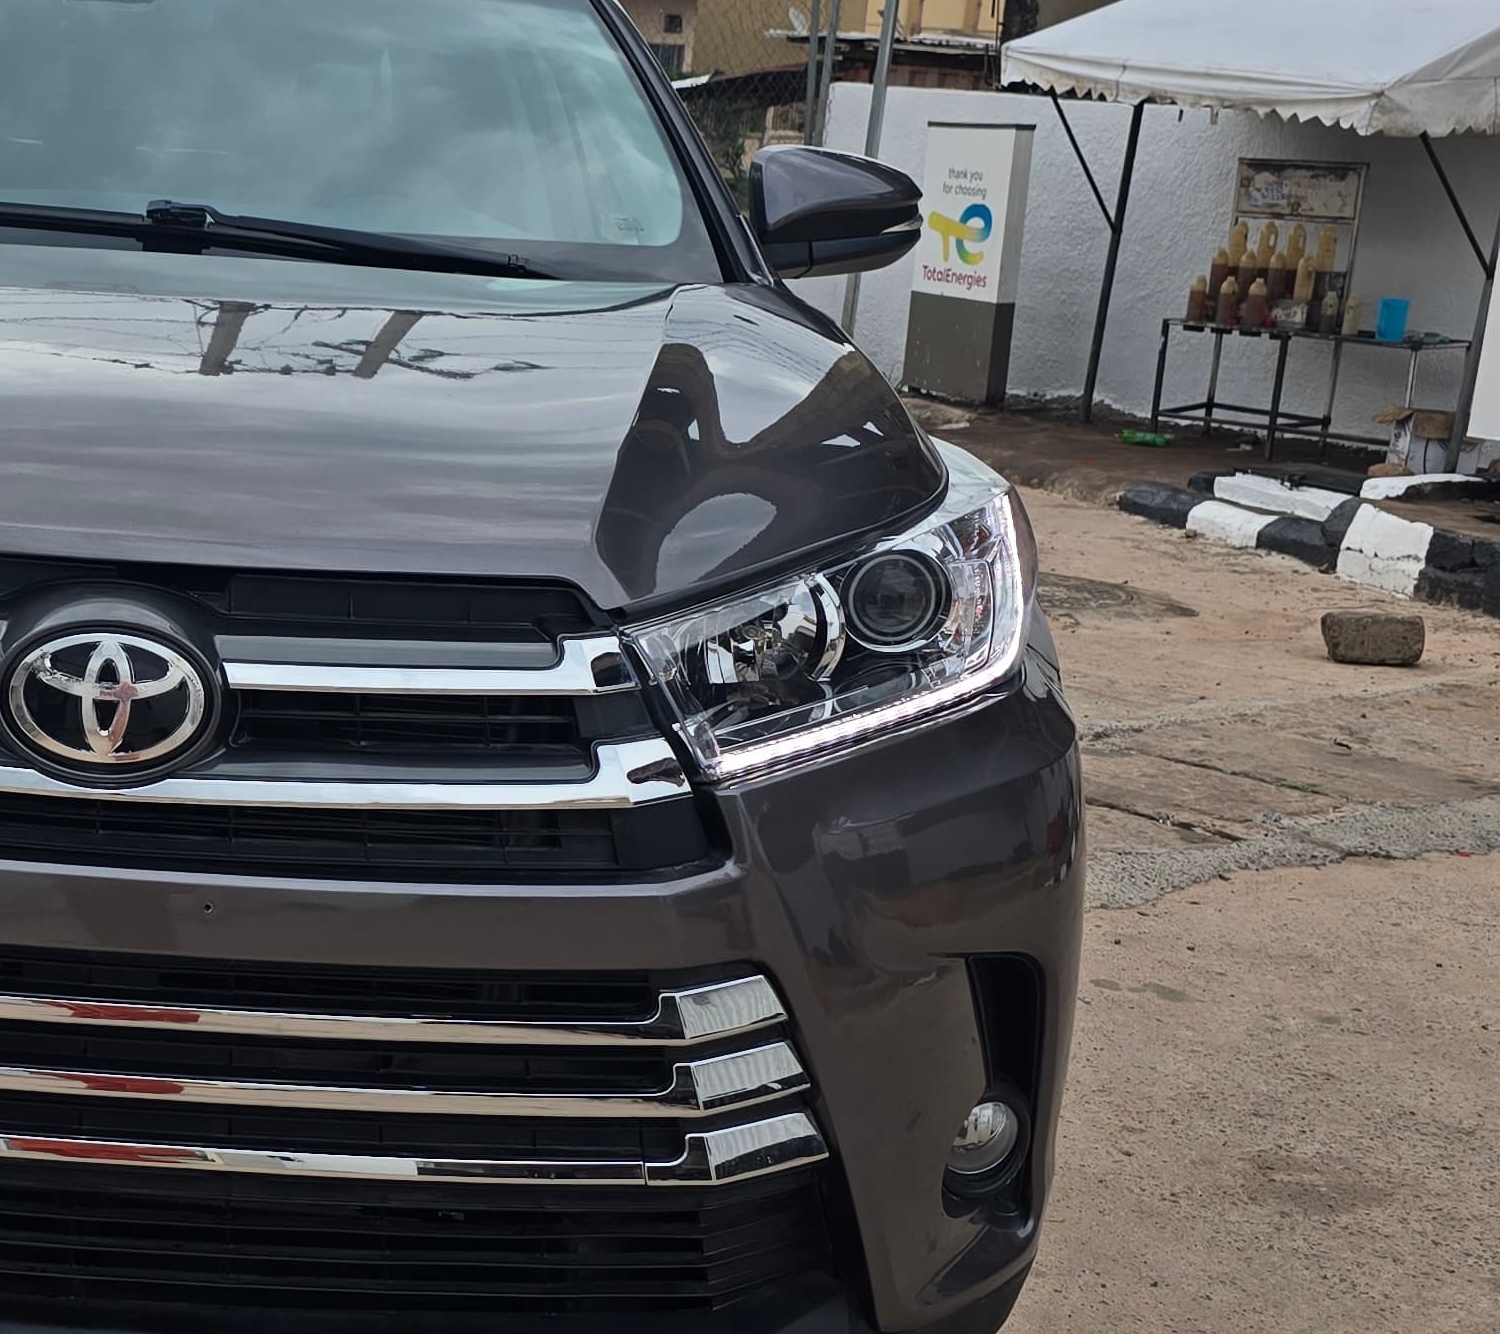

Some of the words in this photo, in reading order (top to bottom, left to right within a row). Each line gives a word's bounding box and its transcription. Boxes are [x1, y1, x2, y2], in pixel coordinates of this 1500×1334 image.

[948, 167, 967, 180] thank
[969, 171, 984, 184] you
[954, 184, 988, 200] choosing
[922, 264, 987, 290] TotalEnergies
